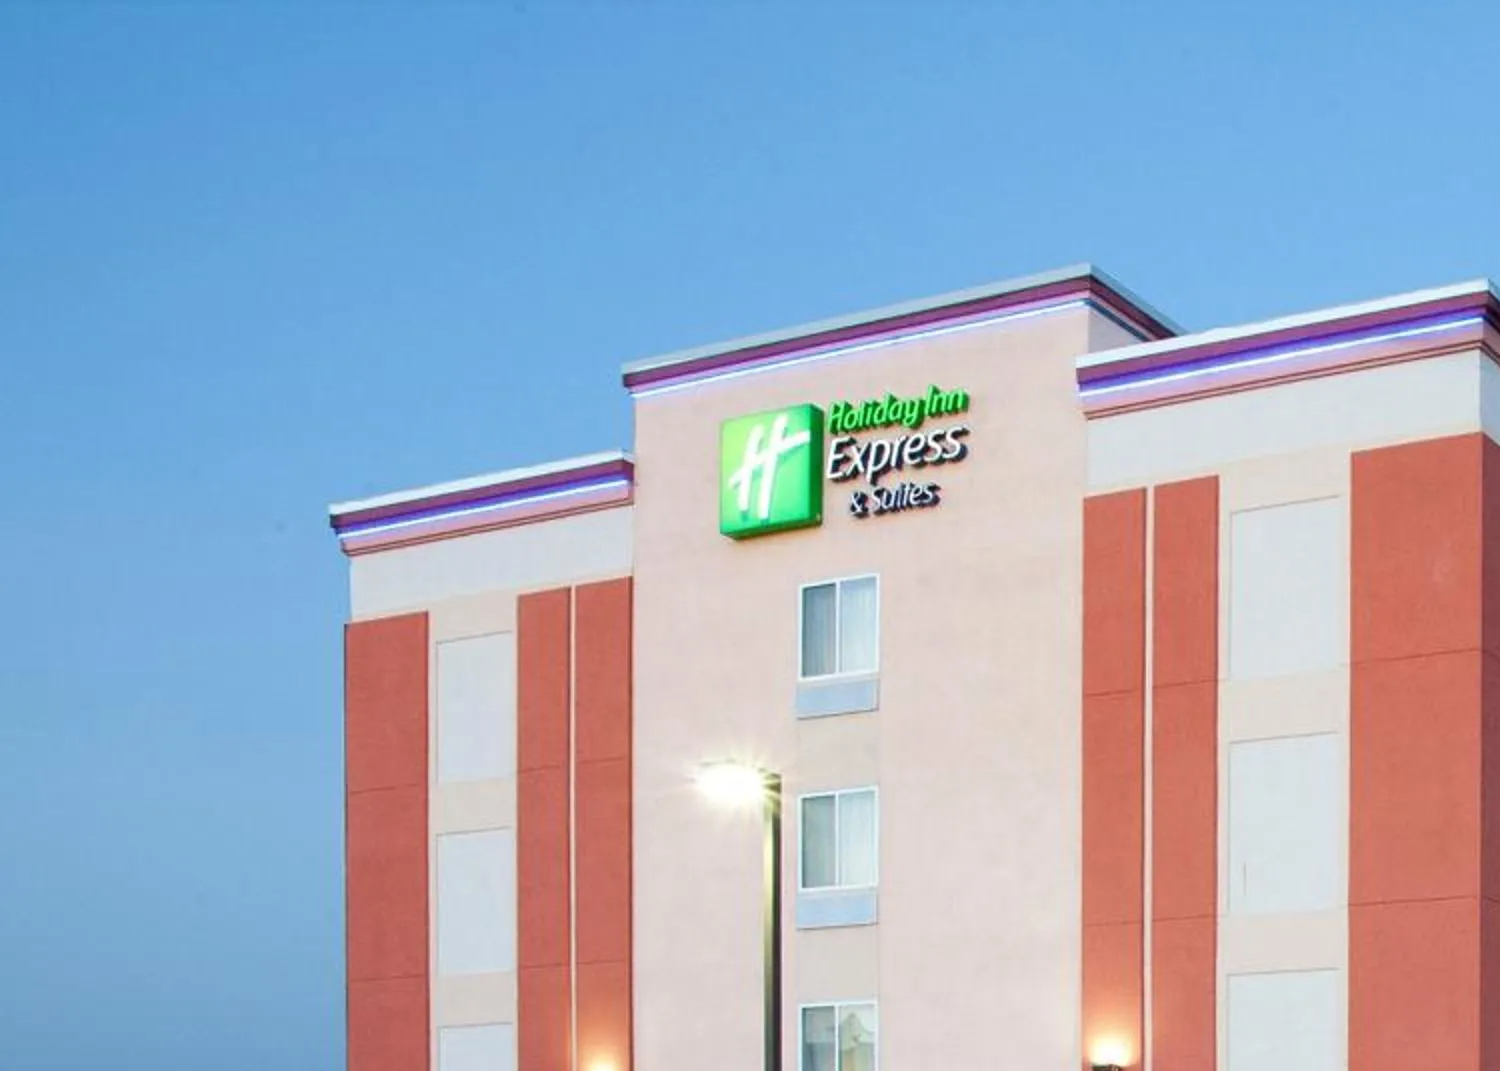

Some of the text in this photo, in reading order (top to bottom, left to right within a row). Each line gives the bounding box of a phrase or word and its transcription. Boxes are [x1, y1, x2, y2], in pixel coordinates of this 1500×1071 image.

[827, 384, 969, 434] Holiday Inn
[826, 425, 969, 483] Express
[850, 482, 940, 516] & Suites
